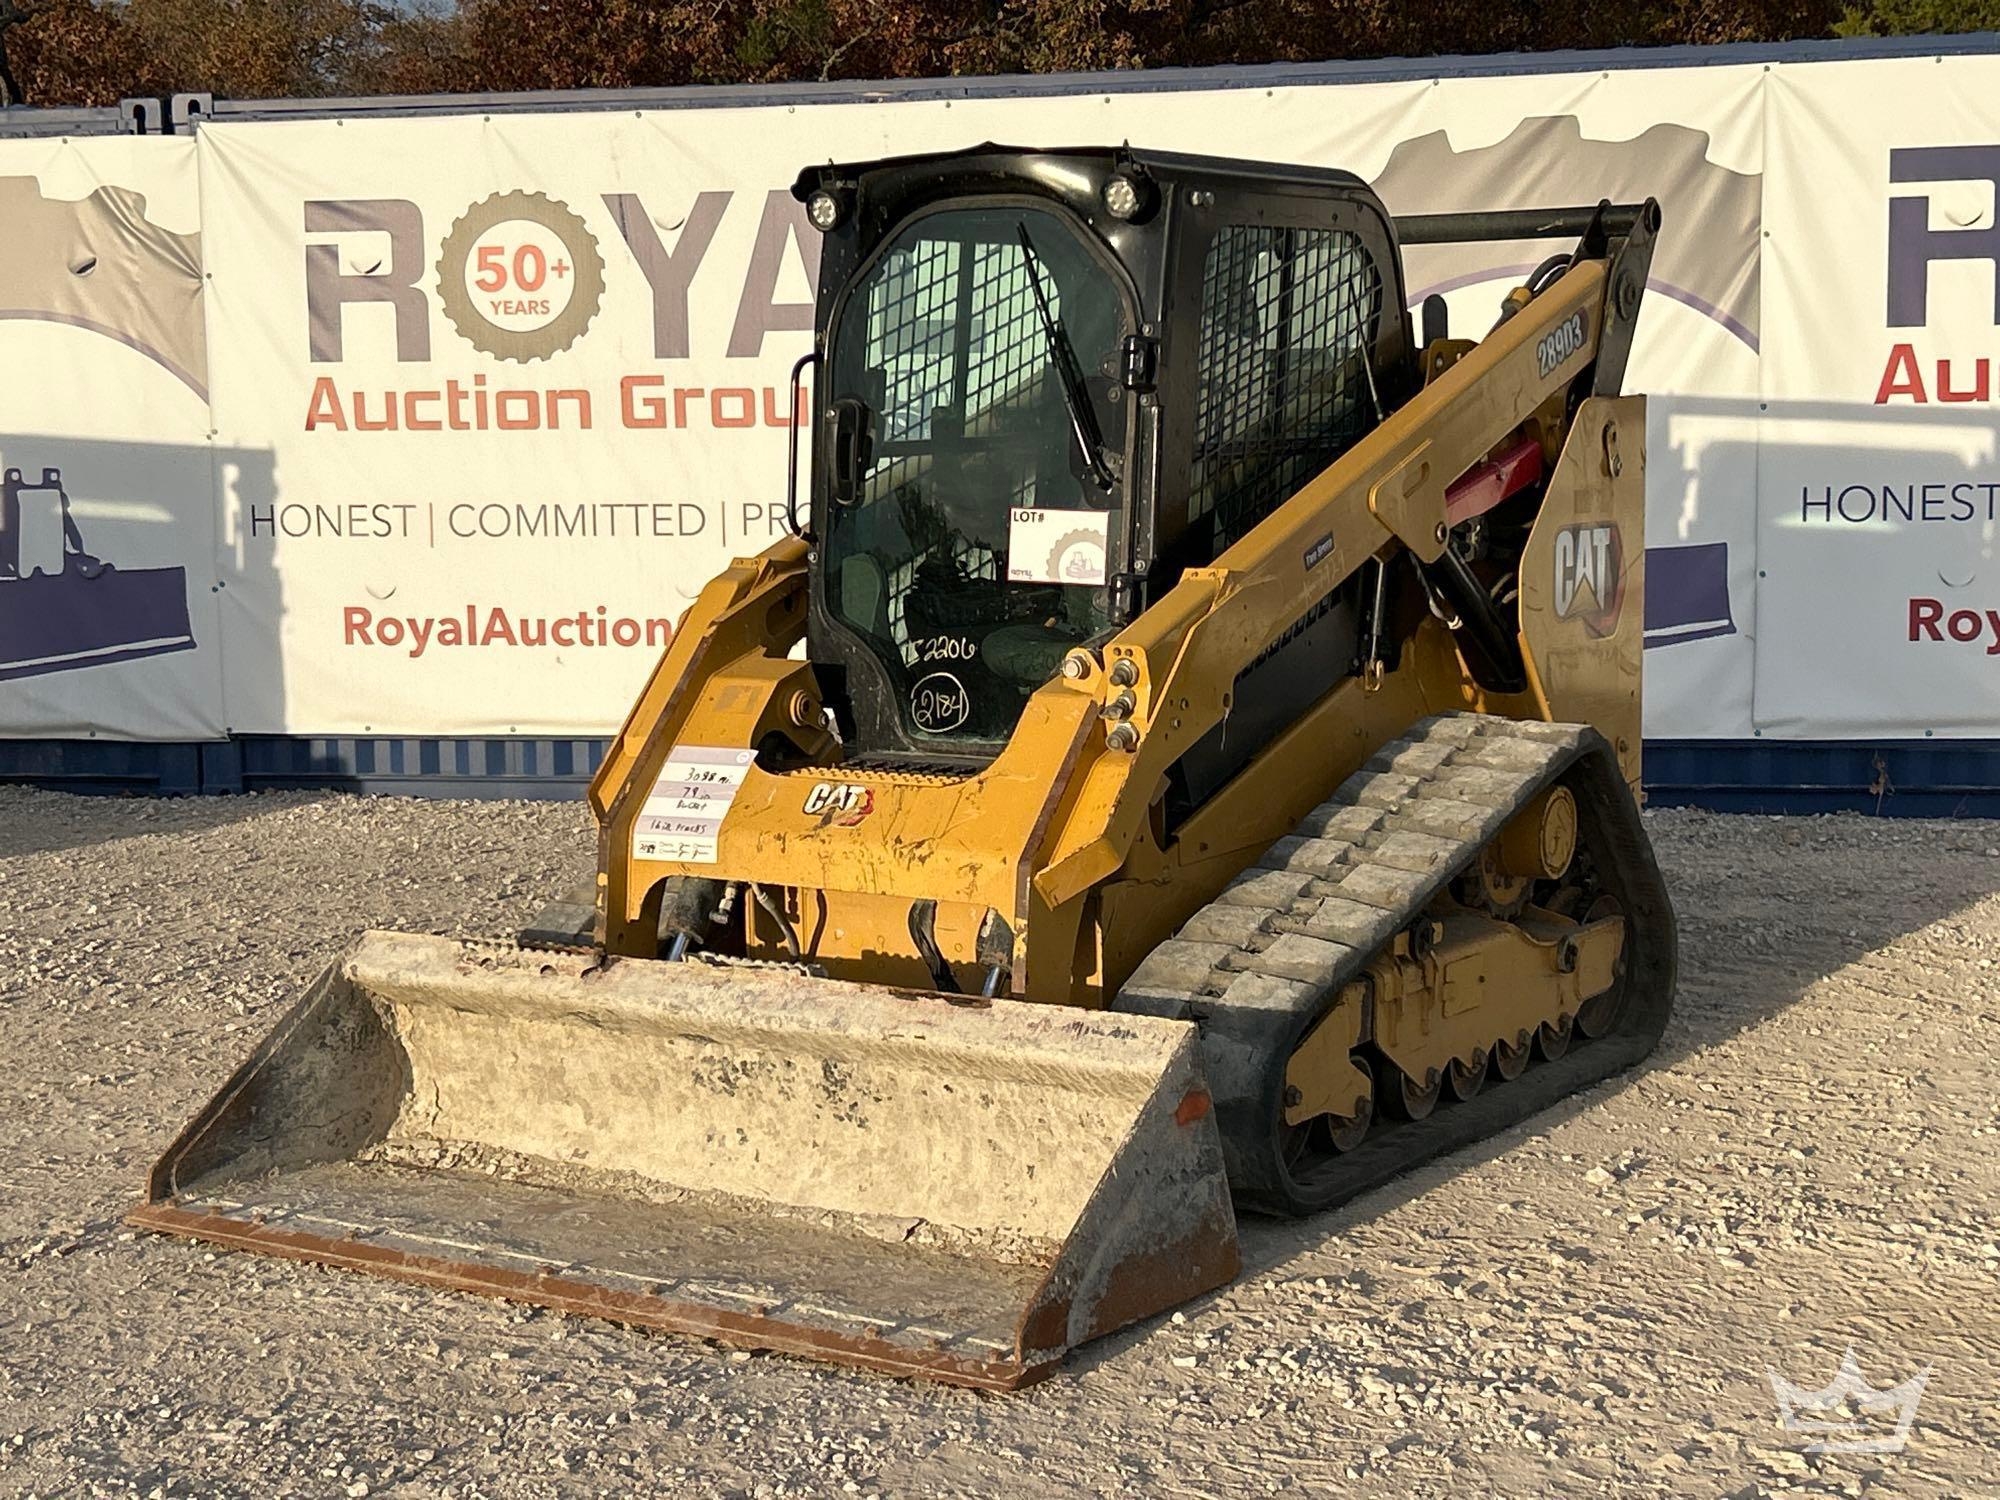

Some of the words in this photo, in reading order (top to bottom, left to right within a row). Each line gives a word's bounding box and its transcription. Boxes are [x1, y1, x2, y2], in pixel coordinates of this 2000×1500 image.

[475, 244, 570, 293] 50+
[490, 300, 551, 316] YEARS
[1537, 313, 1582, 378] 289D3
[304, 374, 593, 432] Auction
[620, 374, 809, 430] Grou
[251, 503, 417, 538] HONEST
[448, 502, 706, 538] COMMITTED
[1013, 511, 1045, 523] LOT#
[1802, 483, 2000, 523] HONEST
[1555, 527, 1610, 617] CAT
[344, 604, 671, 658] RoyalAuction
[803, 783, 866, 813] CAT
